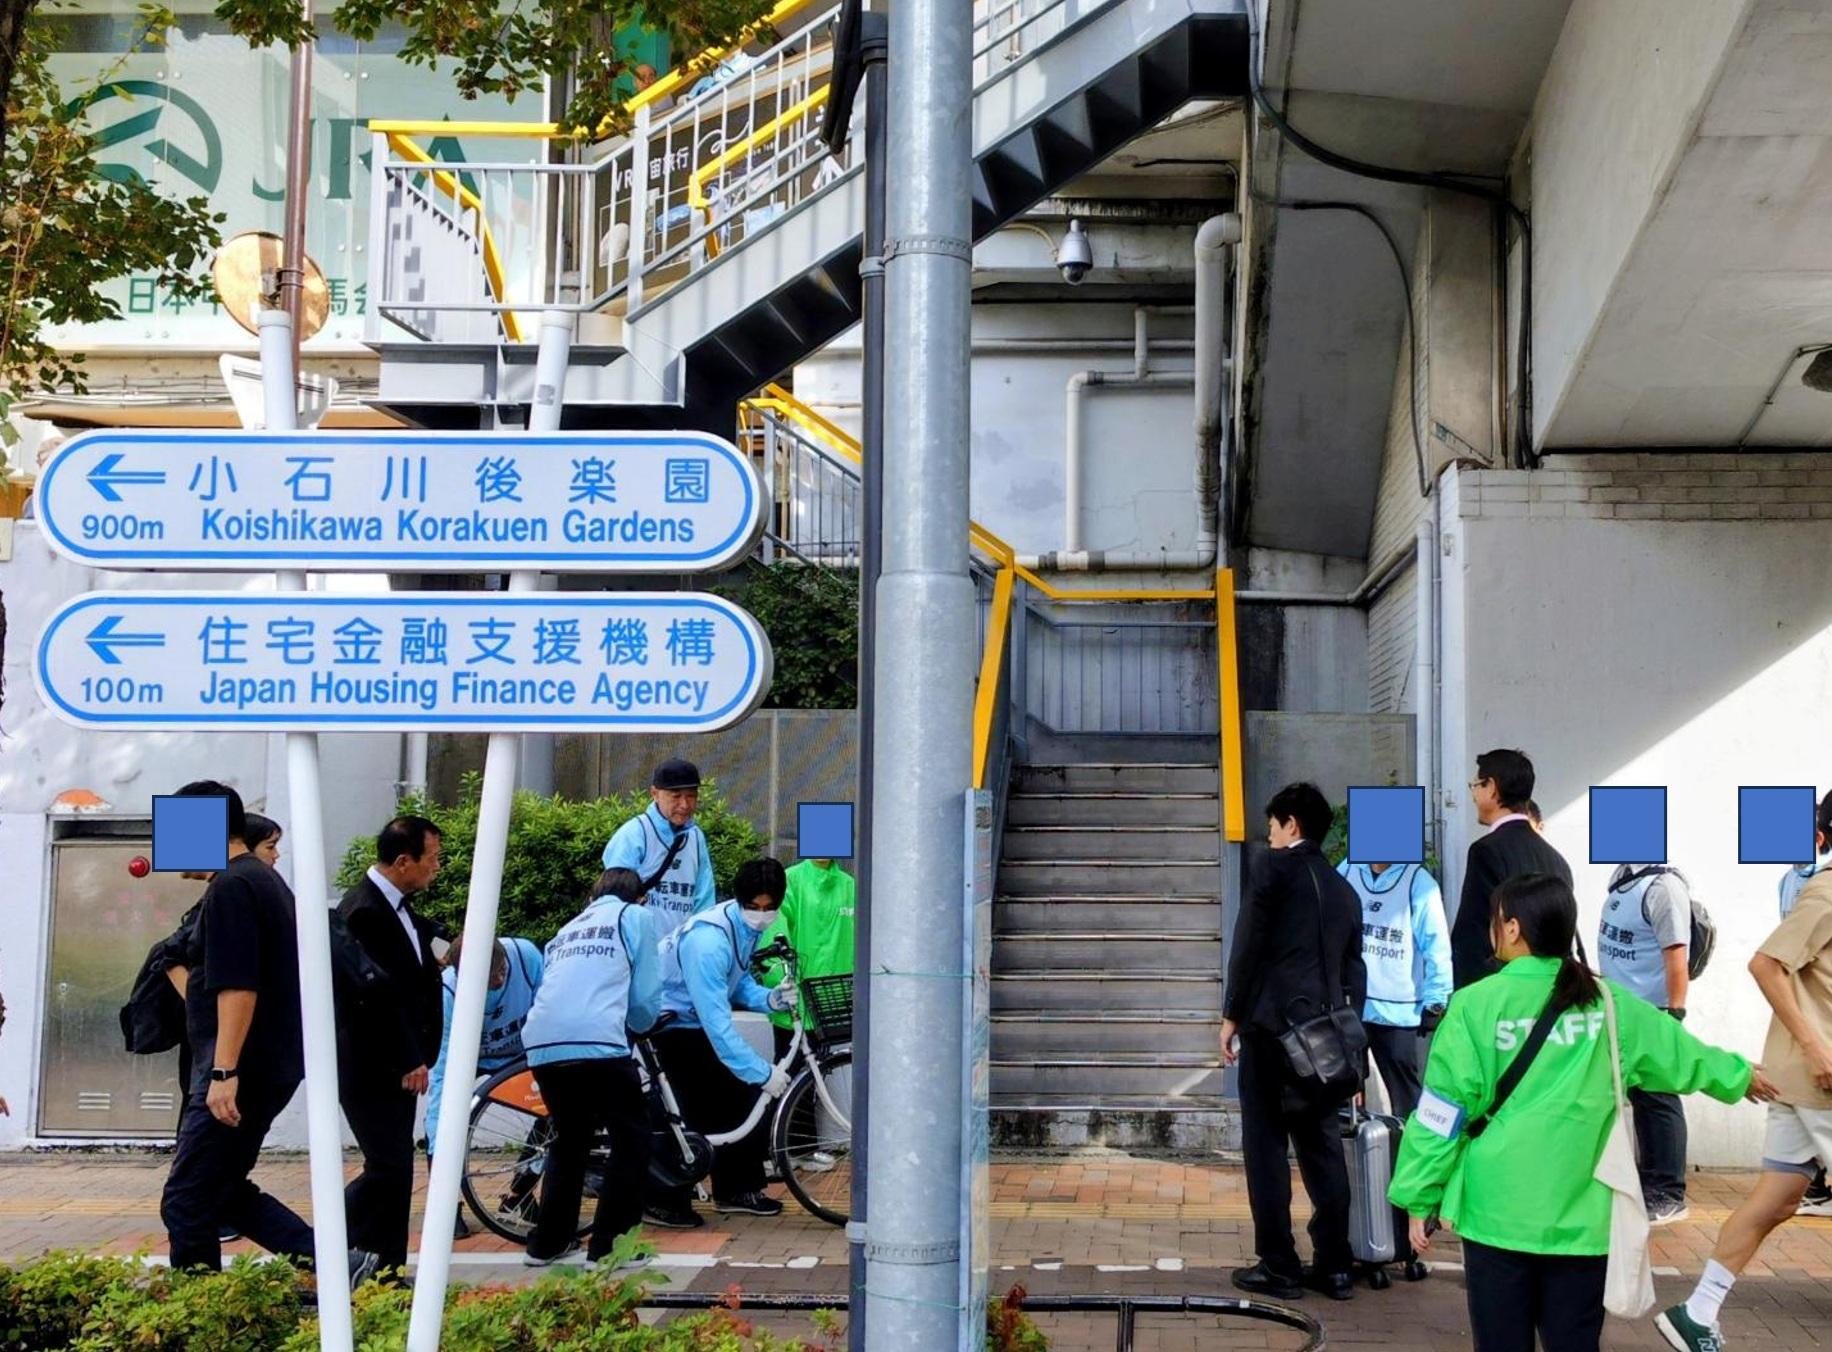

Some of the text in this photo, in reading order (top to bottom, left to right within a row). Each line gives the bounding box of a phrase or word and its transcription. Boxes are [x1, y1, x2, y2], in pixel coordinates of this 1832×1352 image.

[189, 456, 711, 505] 小石川後楽園
[82, 515, 165, 541] 900m
[201, 508, 695, 543] Koishikawa Korakuen Gardens
[198, 616, 715, 667] 住宅金融支援機構
[80, 678, 164, 704] 100m
[200, 672, 709, 712] Japan Housing Finance Agency
[556, 945, 615, 961] Transport
